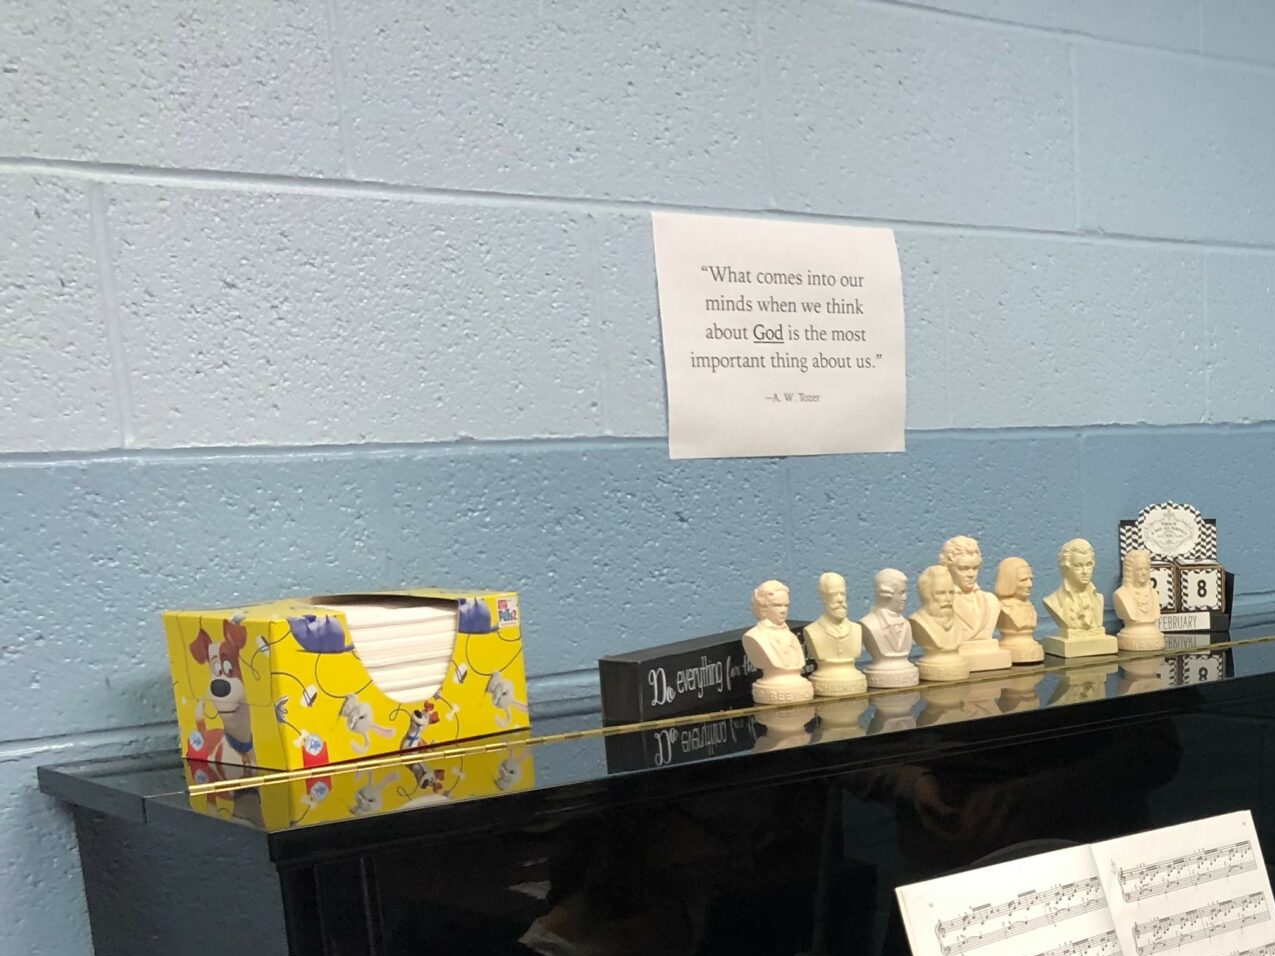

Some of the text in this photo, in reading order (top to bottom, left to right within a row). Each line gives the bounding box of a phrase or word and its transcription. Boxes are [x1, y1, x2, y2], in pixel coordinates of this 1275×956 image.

[757, 272, 803, 285] comes
[808, 270, 836, 286] into
[840, 276, 864, 287] our
[705, 295, 864, 314] minds when we think
[706, 323, 866, 344] about God is the most
[691, 352, 766, 373] important
[771, 352, 808, 373] thing
[812, 352, 851, 368] about
[1197, 579, 1208, 598] 8
[1158, 615, 1197, 630] FEBRUARY
[649, 668, 676, 706] Do
[676, 656, 723, 698] everything
